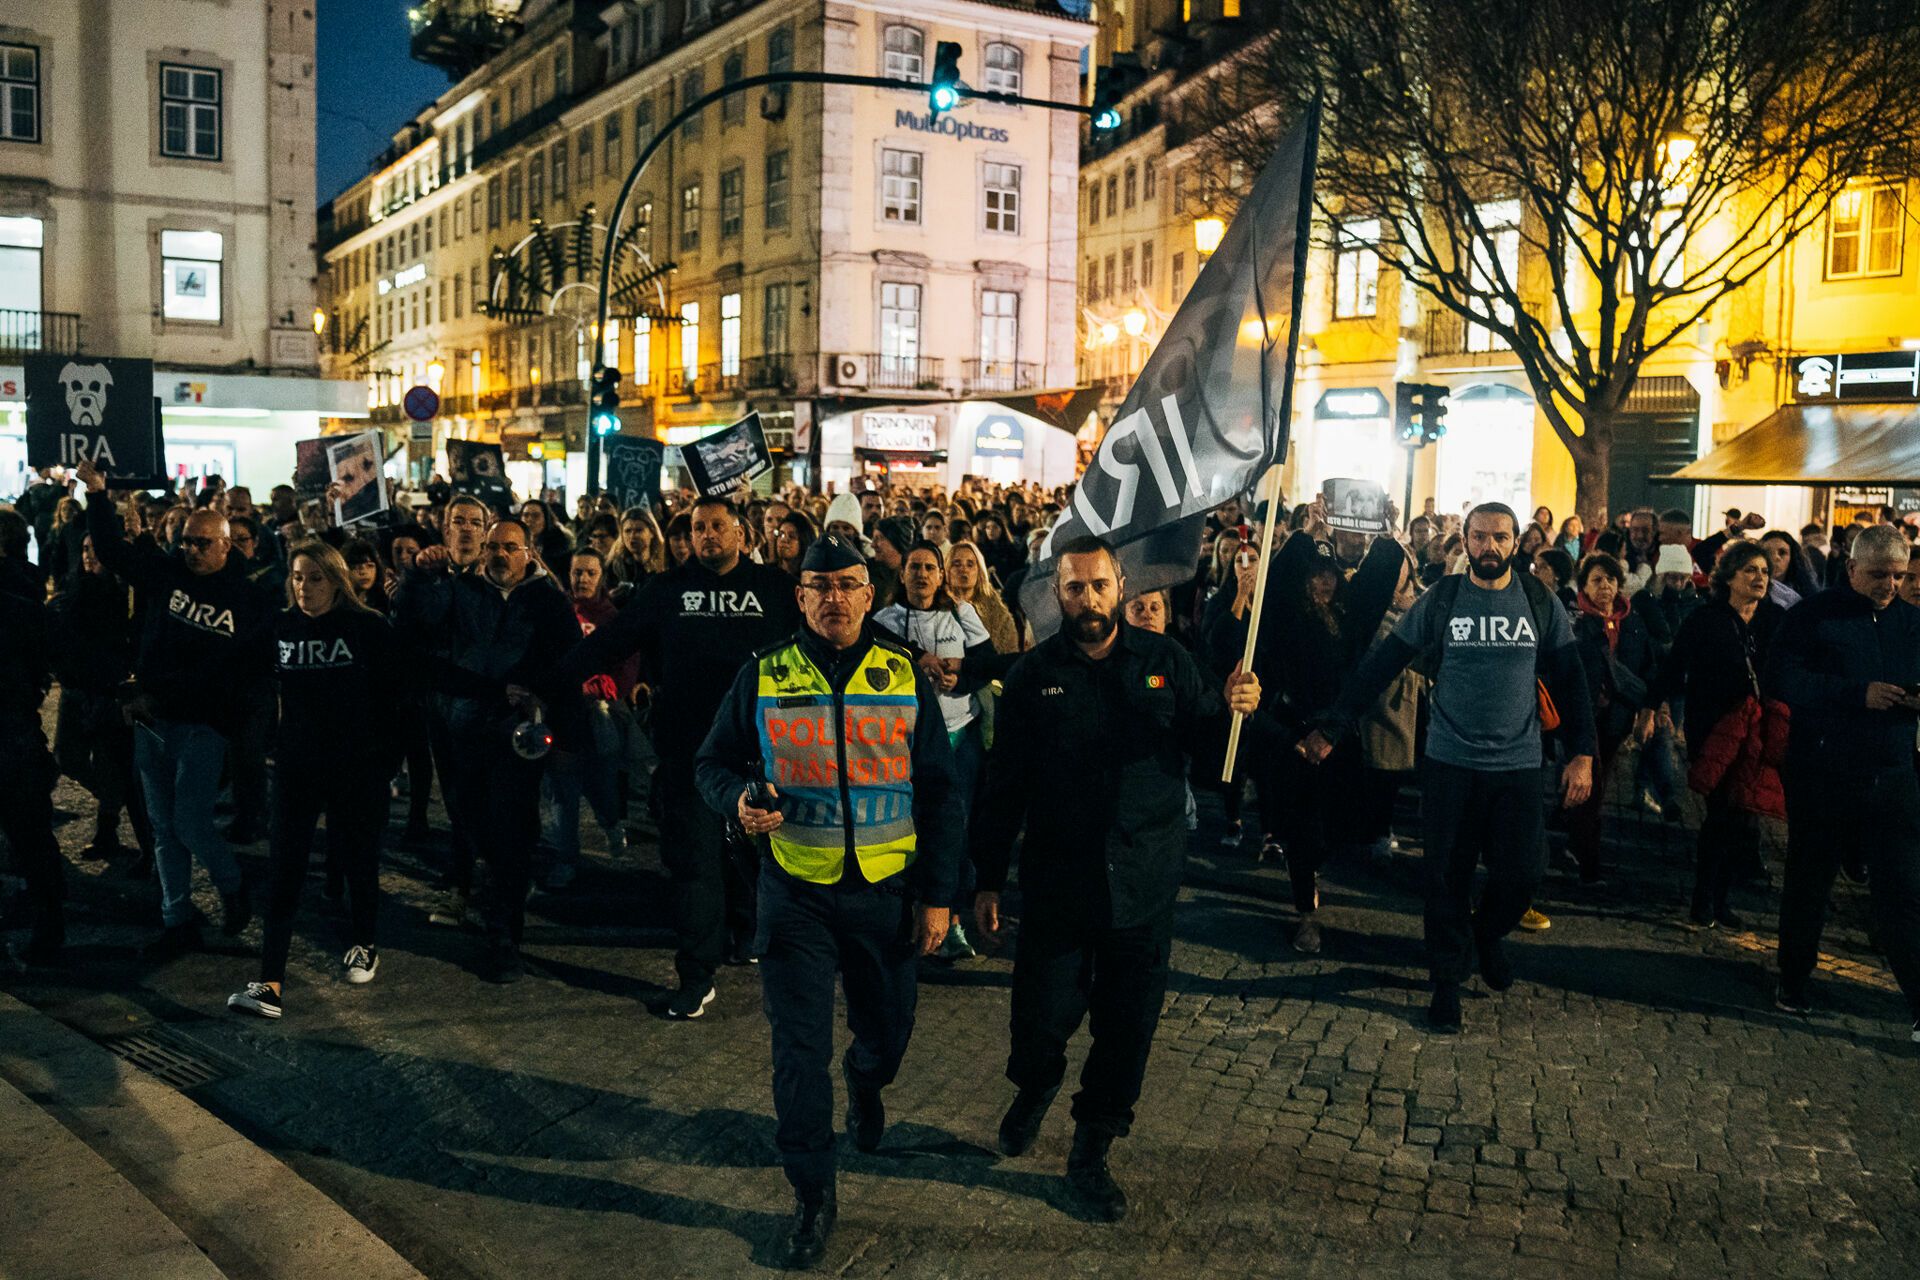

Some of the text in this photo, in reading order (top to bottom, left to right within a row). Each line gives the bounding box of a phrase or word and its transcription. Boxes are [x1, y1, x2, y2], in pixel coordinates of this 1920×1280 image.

[60, 433, 116, 467] IRA
[615, 487, 656, 511] IRA
[707, 483, 726, 496] ISTO
[709, 590, 763, 613] IRA
[186, 601, 235, 634] IRA
[1479, 616, 1536, 641] IRA
[297, 638, 353, 664] IRA
[1048, 686, 1064, 695] IRA
[768, 709, 907, 746] POLÍCIA
[775, 754, 907, 785] TRÂNSITO
